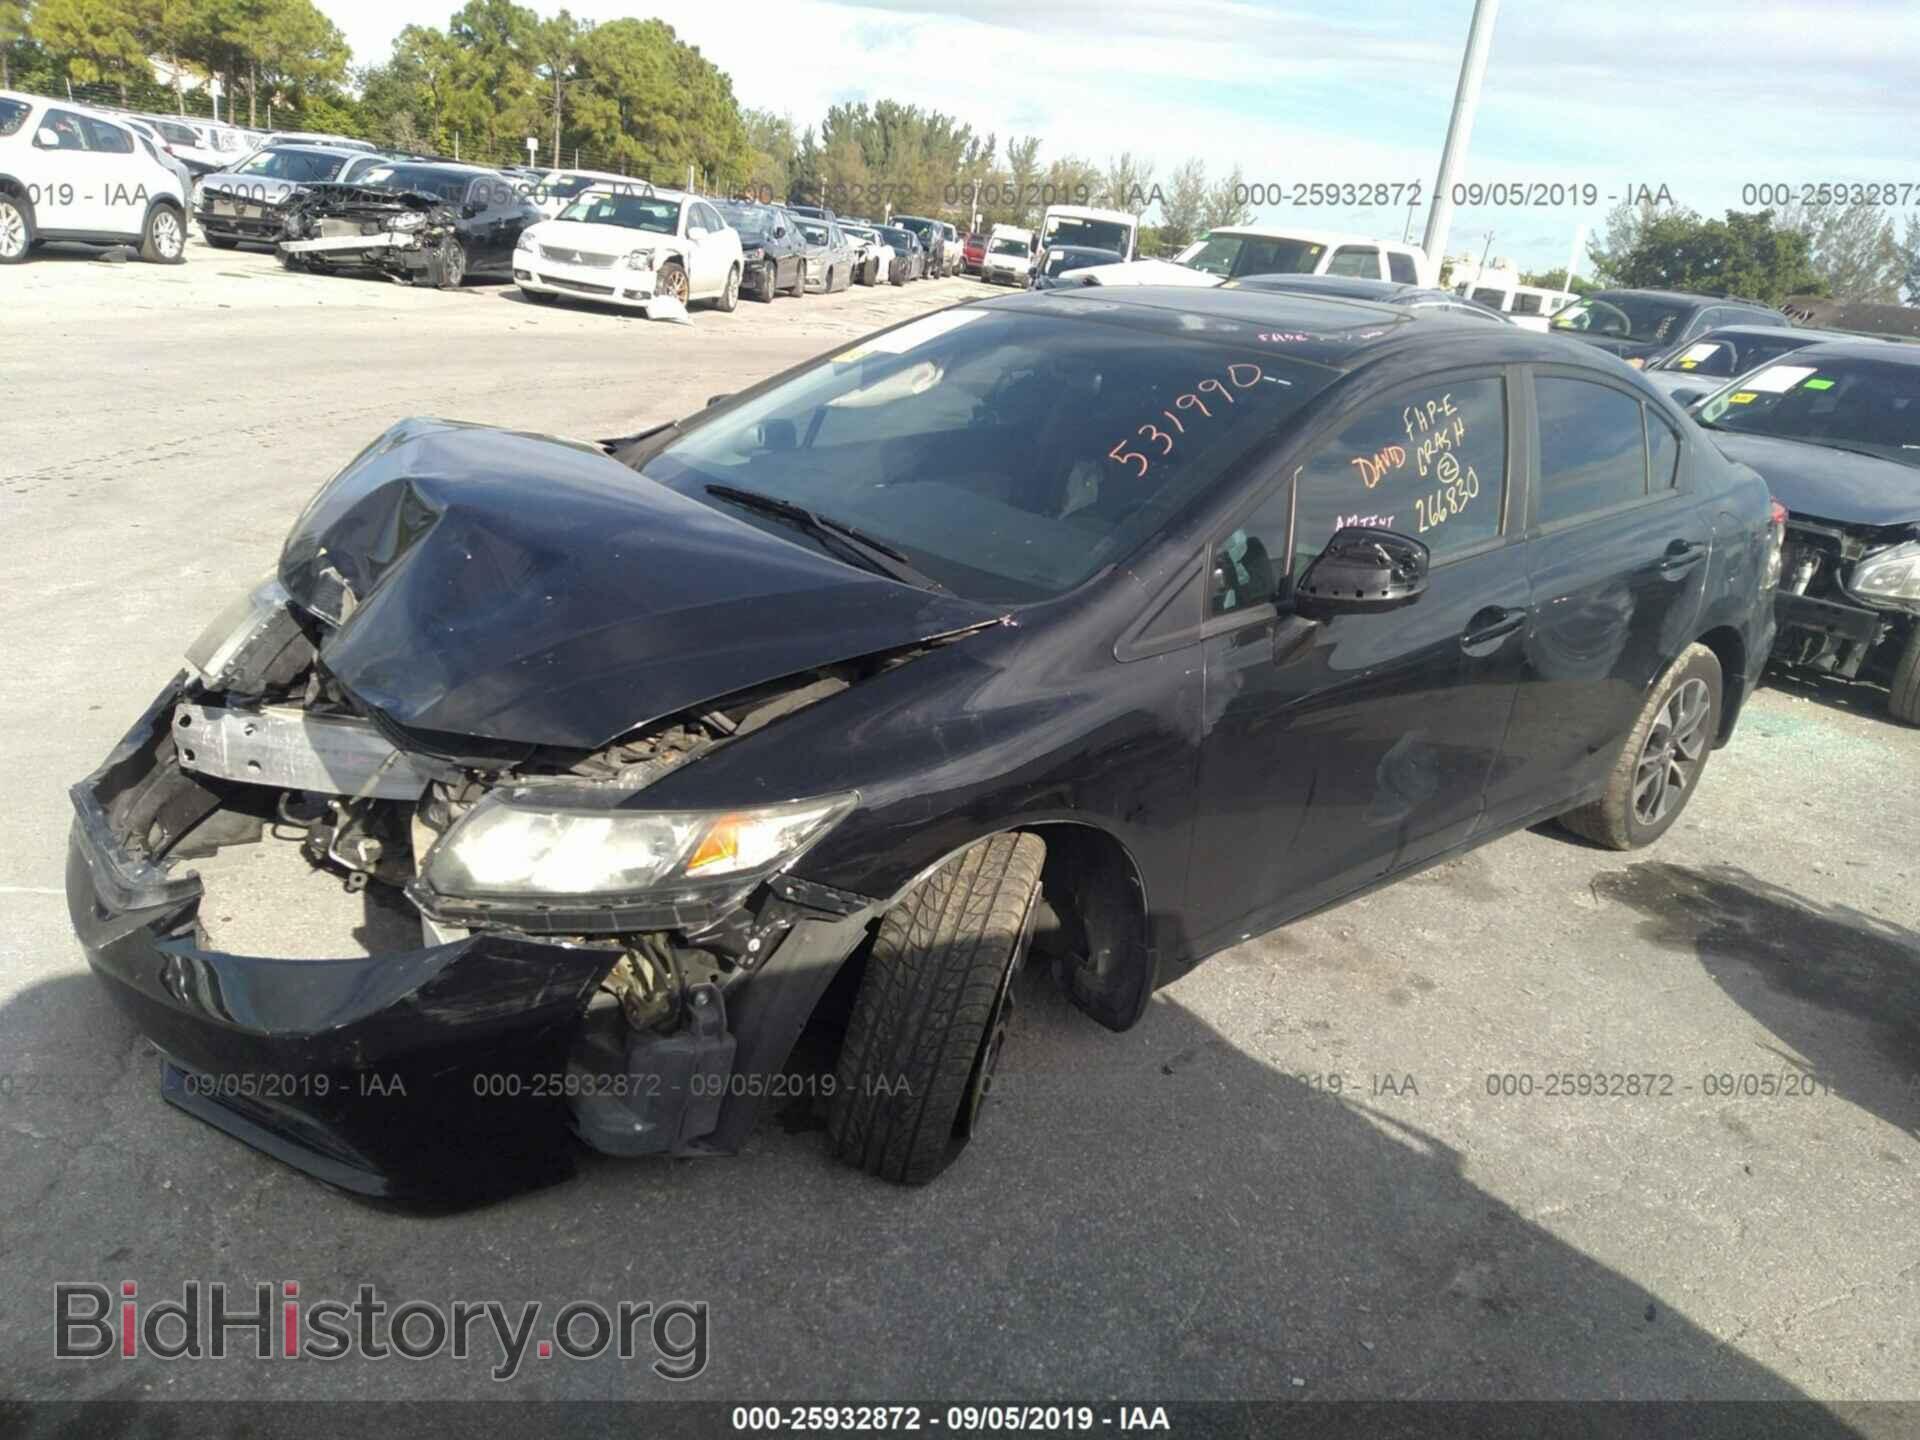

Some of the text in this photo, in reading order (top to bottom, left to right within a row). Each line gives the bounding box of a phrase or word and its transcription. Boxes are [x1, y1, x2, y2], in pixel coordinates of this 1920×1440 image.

[1108, 363, 1261, 478] 531990
[1416, 417, 1465, 477] CRASH
[1415, 465, 1480, 533] 266830
